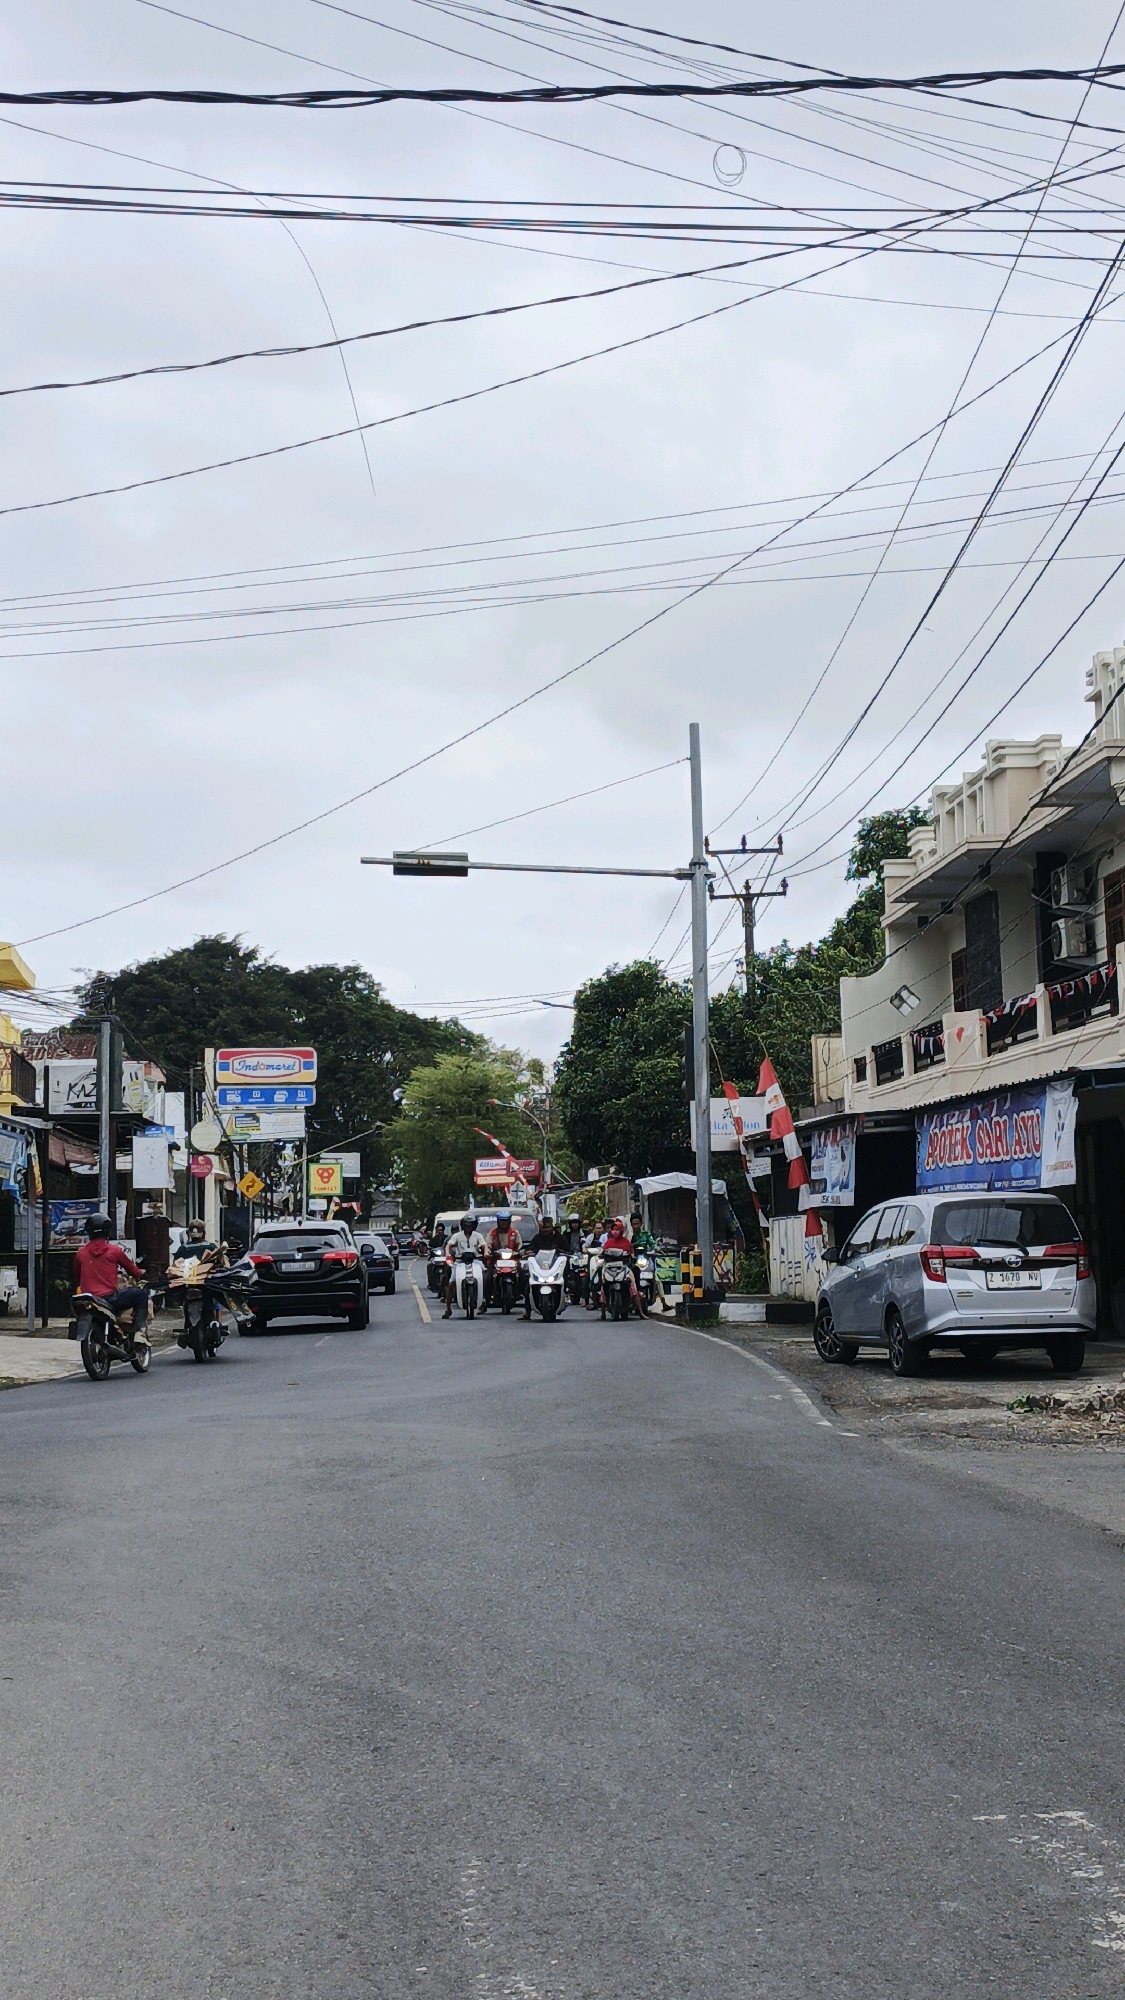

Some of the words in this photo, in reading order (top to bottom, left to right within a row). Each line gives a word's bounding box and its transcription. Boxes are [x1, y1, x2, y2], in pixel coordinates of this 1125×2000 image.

[235, 1060, 296, 1071] Indomaret
[925, 1121, 973, 1170] APOTEK
[976, 1115, 1011, 1164] SARI
[1012, 1109, 1042, 1159] AYU
